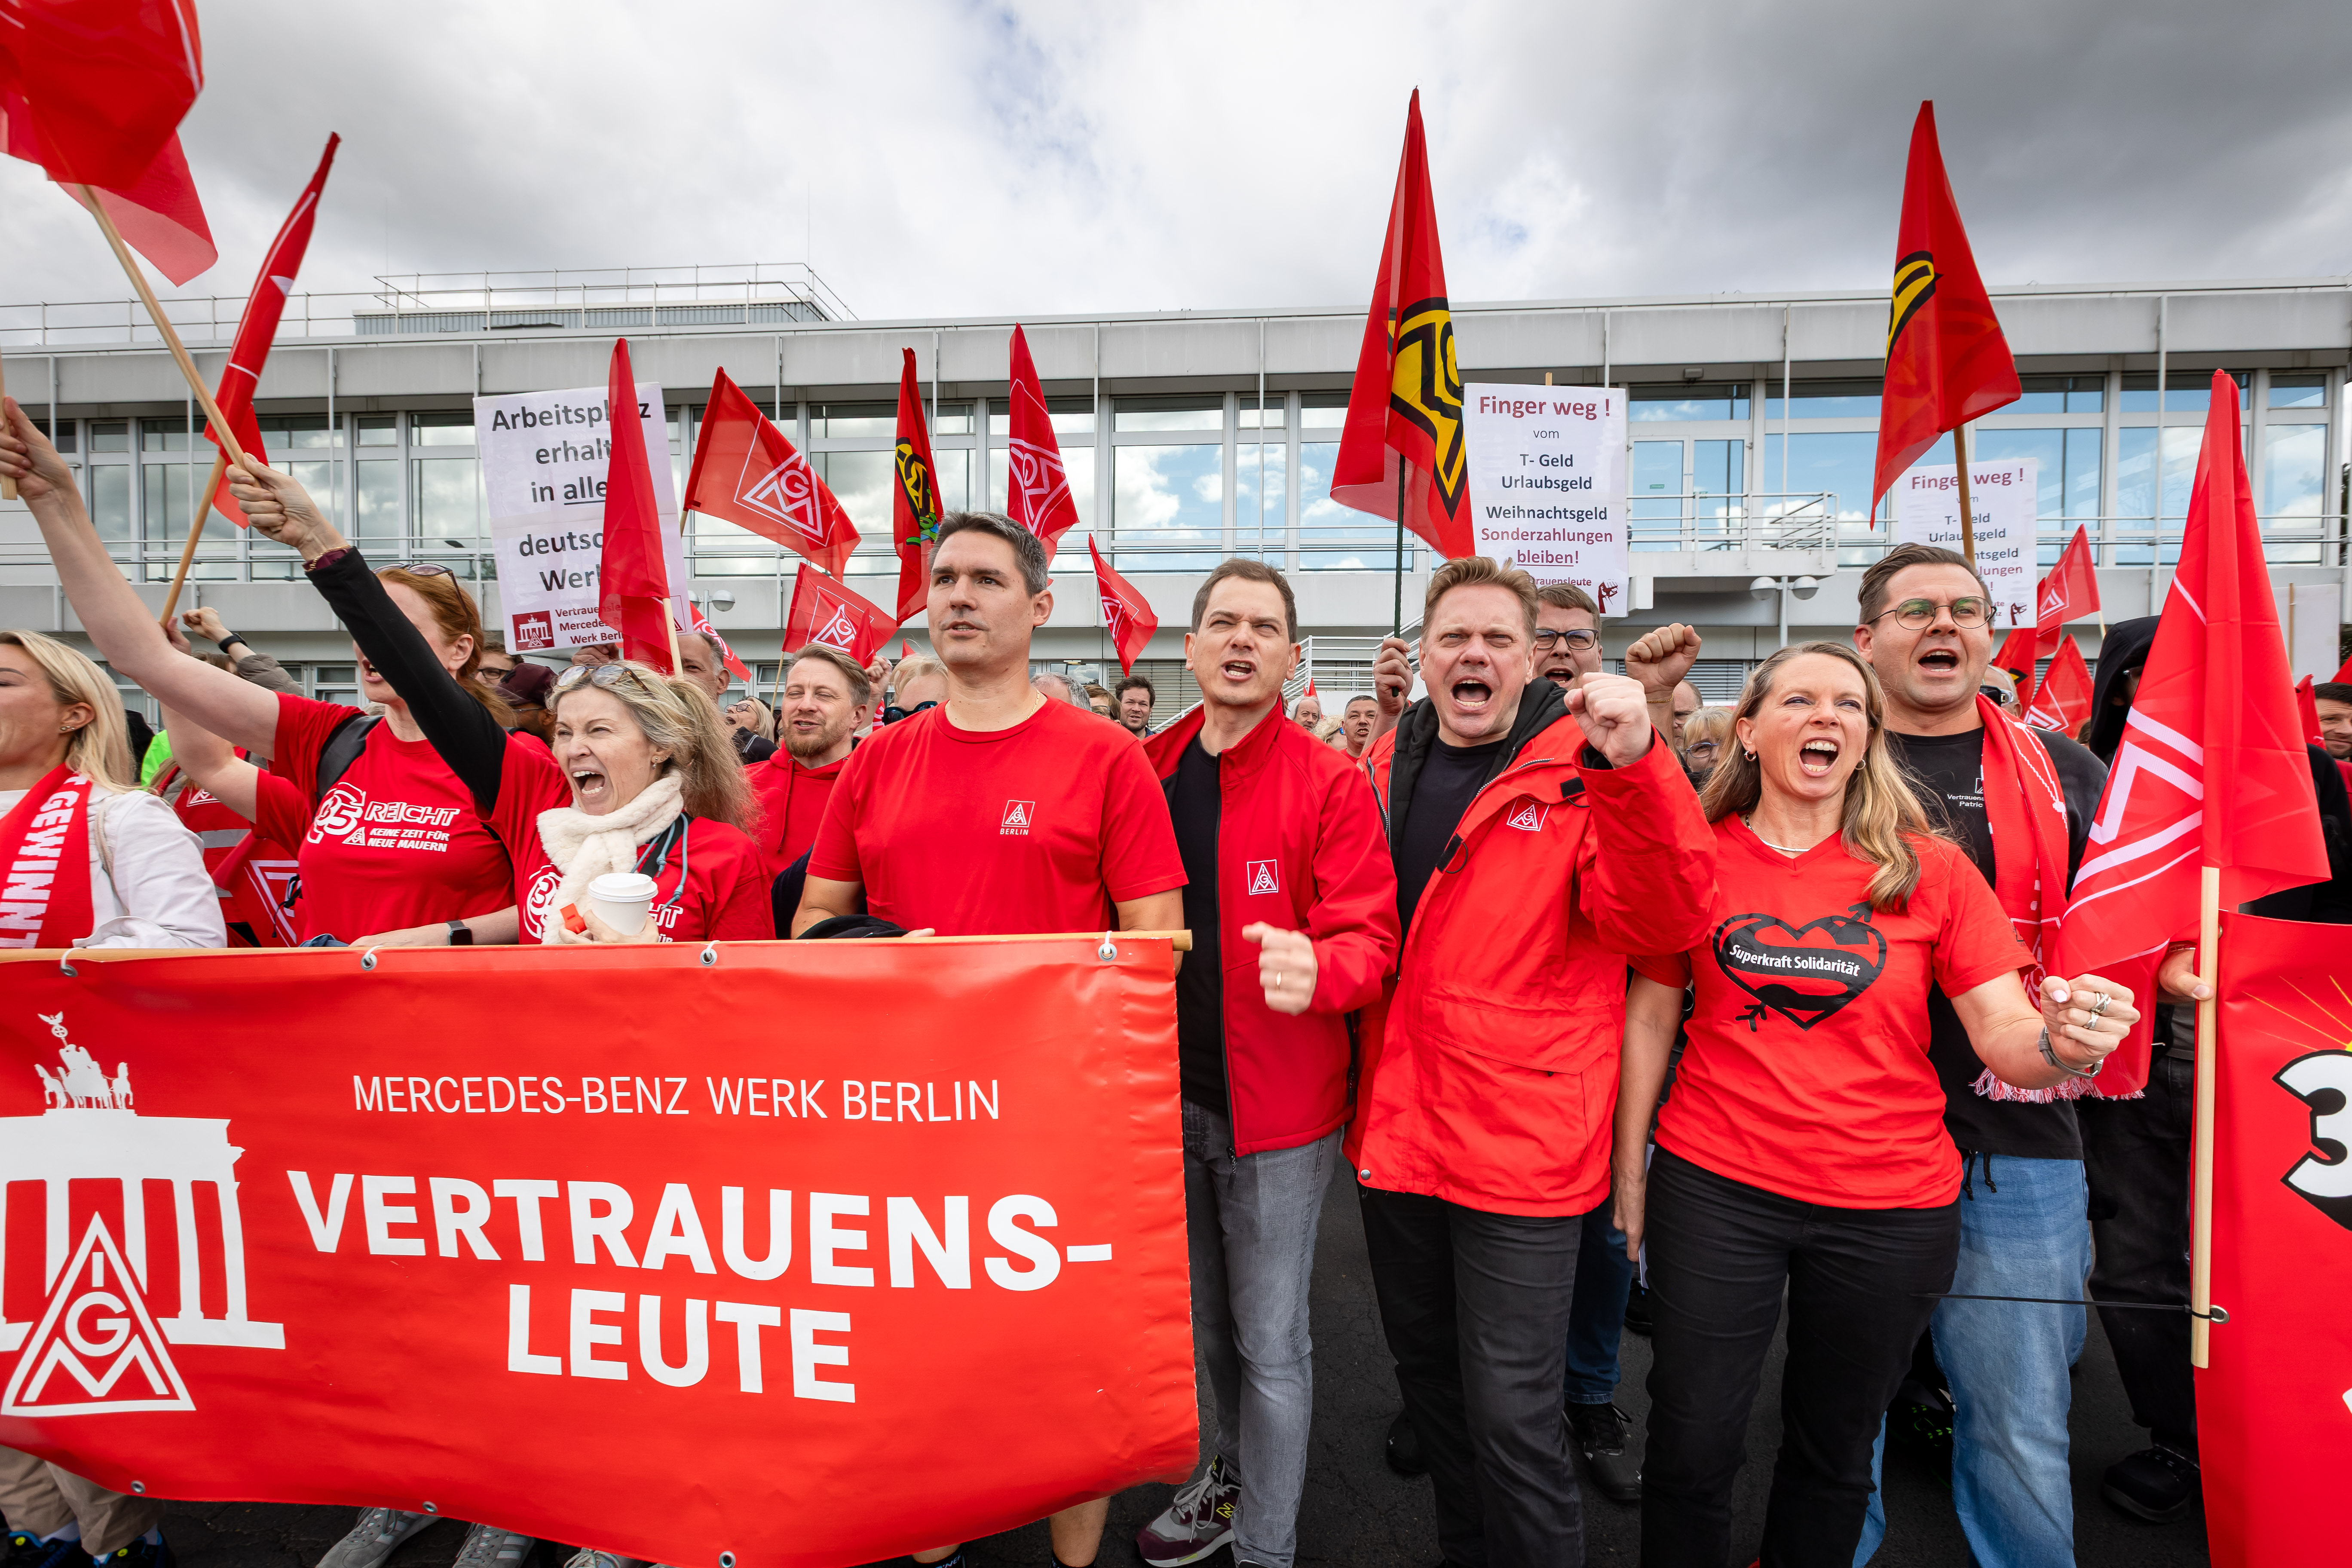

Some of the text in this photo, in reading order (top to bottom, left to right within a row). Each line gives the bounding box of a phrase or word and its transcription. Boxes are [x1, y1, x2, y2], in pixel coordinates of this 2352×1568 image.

[492, 399, 651, 431] Arbeitsplz
[1480, 396, 1610, 420] Finger weg !
[1533, 429, 1559, 438] vom
[536, 438, 612, 464] erhalt
[1520, 454, 1574, 467] T- Geld
[531, 476, 607, 502] in alle
[1502, 475, 1592, 492] Urlaubsgeld
[1912, 475, 1959, 490] Finge
[1974, 472, 2012, 486] weg
[1486, 506, 1608, 523] Weihnachtsgeld
[1971, 513, 1990, 524] eld
[1481, 528, 1613, 545] Sonderzahlungen
[1929, 528, 2006, 542] Urlausgeld
[519, 532, 603, 557] deutsc
[1517, 550, 1579, 565] bleiben!
[1535, 577, 1592, 586] rauensleute
[570, 633, 598, 644] Werk
[364, 801, 460, 827] REICHT
[369, 828, 450, 841] KEINE ZEIT FÜR
[367, 837, 448, 852] NEUE MAUERN
[1730, 944, 1861, 977] Superkraft Solidarität
[352, 1075, 999, 1122] MERCEDES-BENZ WERK BERLIN
[286, 1170, 1112, 1291] VERTRAUENS-
[508, 1284, 855, 1403] LEUTE
